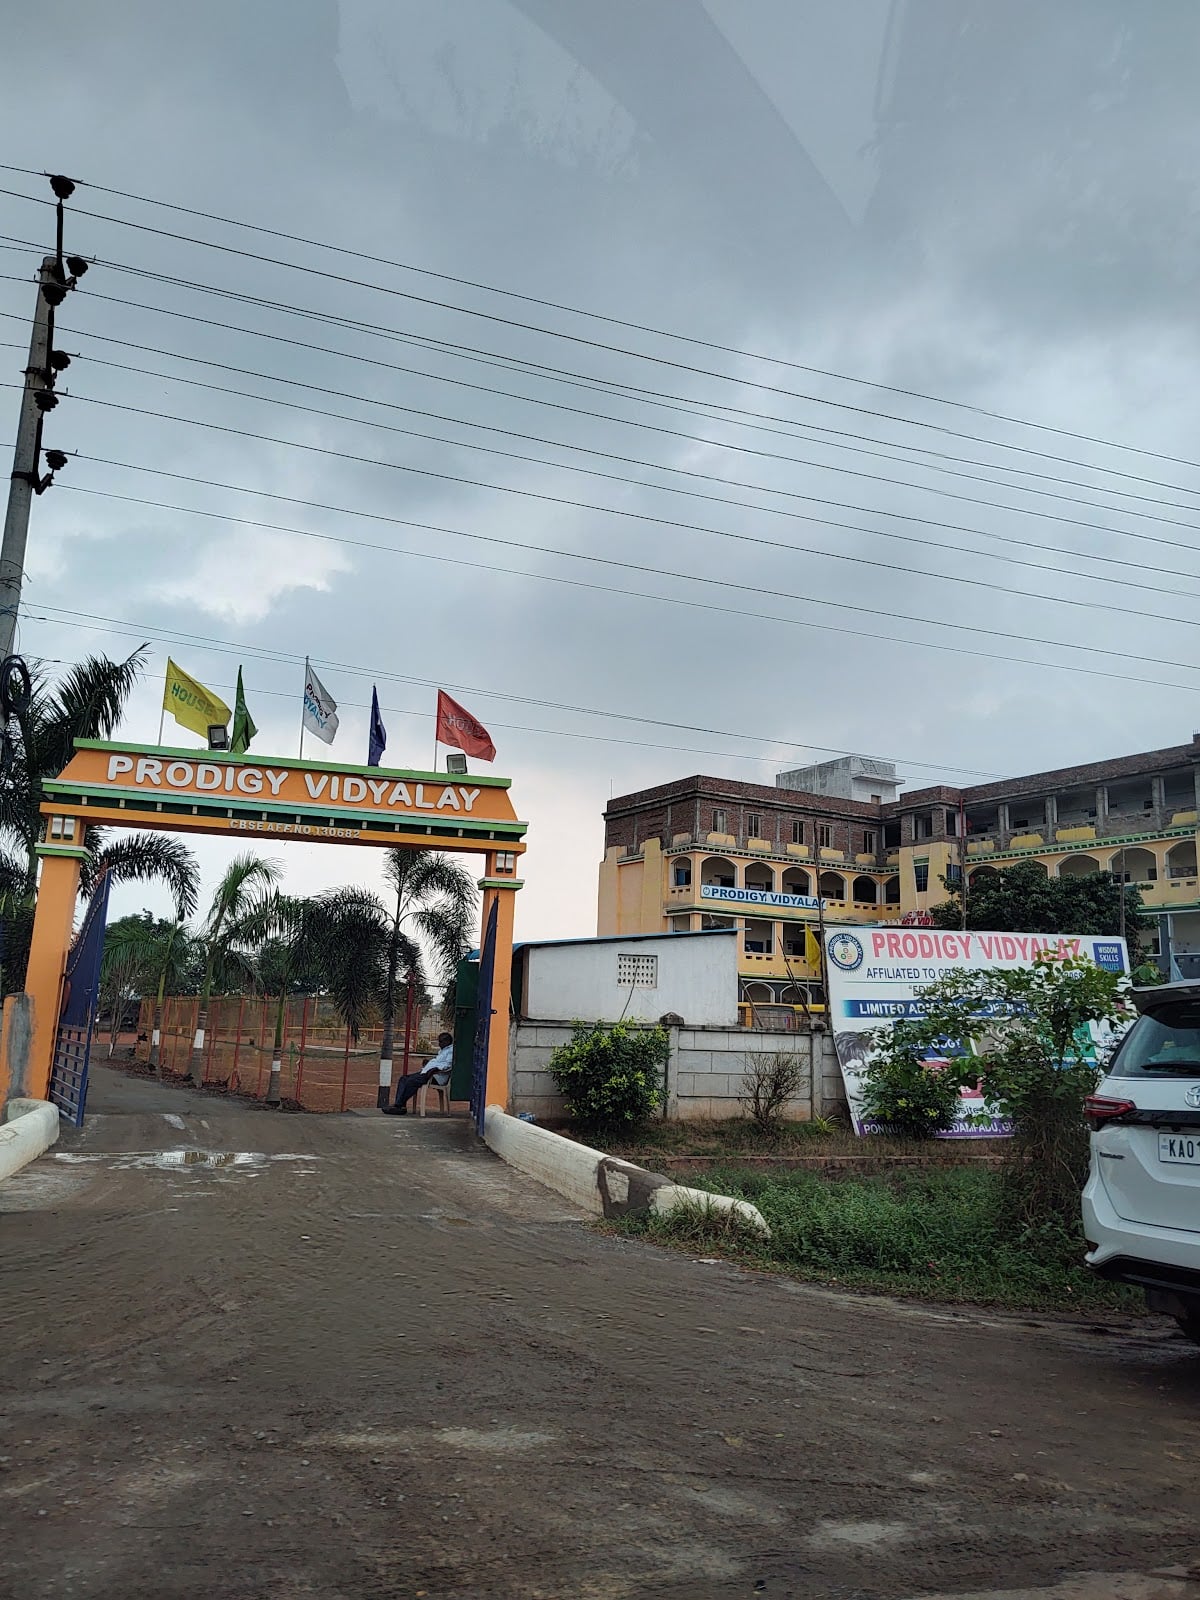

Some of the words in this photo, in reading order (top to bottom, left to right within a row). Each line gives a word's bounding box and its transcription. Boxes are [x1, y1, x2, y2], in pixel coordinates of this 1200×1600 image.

[171, 682, 214, 717] HOUSE
[107, 755, 289, 796] PRODIGY
[304, 772, 481, 812] VIDYALAY
[229, 819, 264, 831] CBSE
[711, 888, 766, 902] PRODIGY
[770, 894, 826, 909] VIDYALAY
[872, 933, 971, 960] PRODIGY
[978, 935, 1081, 962] VIDYALAY
[1097, 946, 1118, 954] WISDOM
[1099, 954, 1119, 962] SKILLS
[866, 968, 919, 979] AFFILIATED
[922, 968, 936, 979] TO
[859, 1003, 904, 1015] LIMITED
